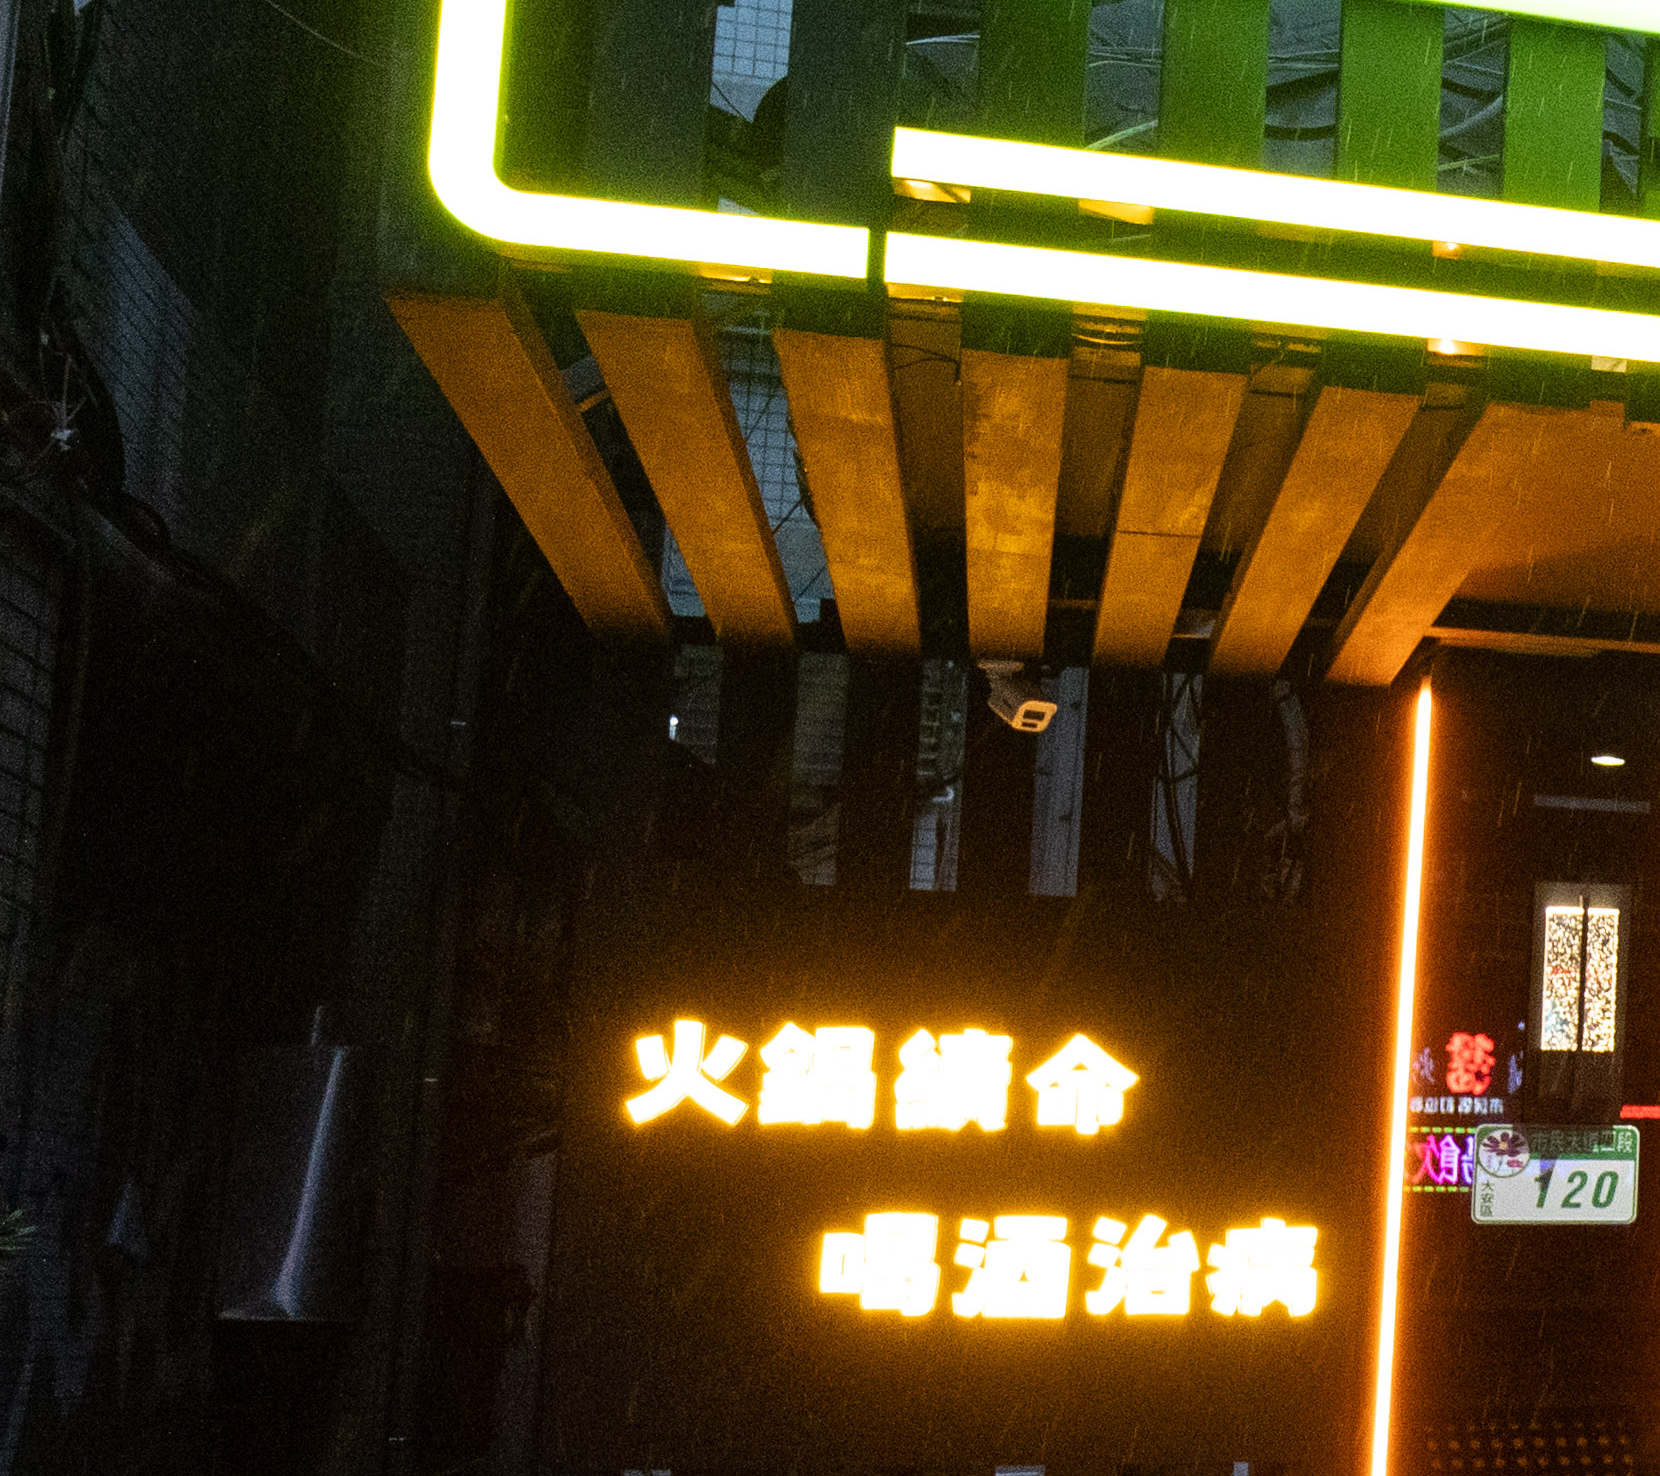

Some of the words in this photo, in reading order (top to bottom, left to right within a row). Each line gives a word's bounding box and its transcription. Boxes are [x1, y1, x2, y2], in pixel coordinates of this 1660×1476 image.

[1534, 1169, 1620, 1209] 120
[820, 1212, 1318, 1318] 喝酒治病
